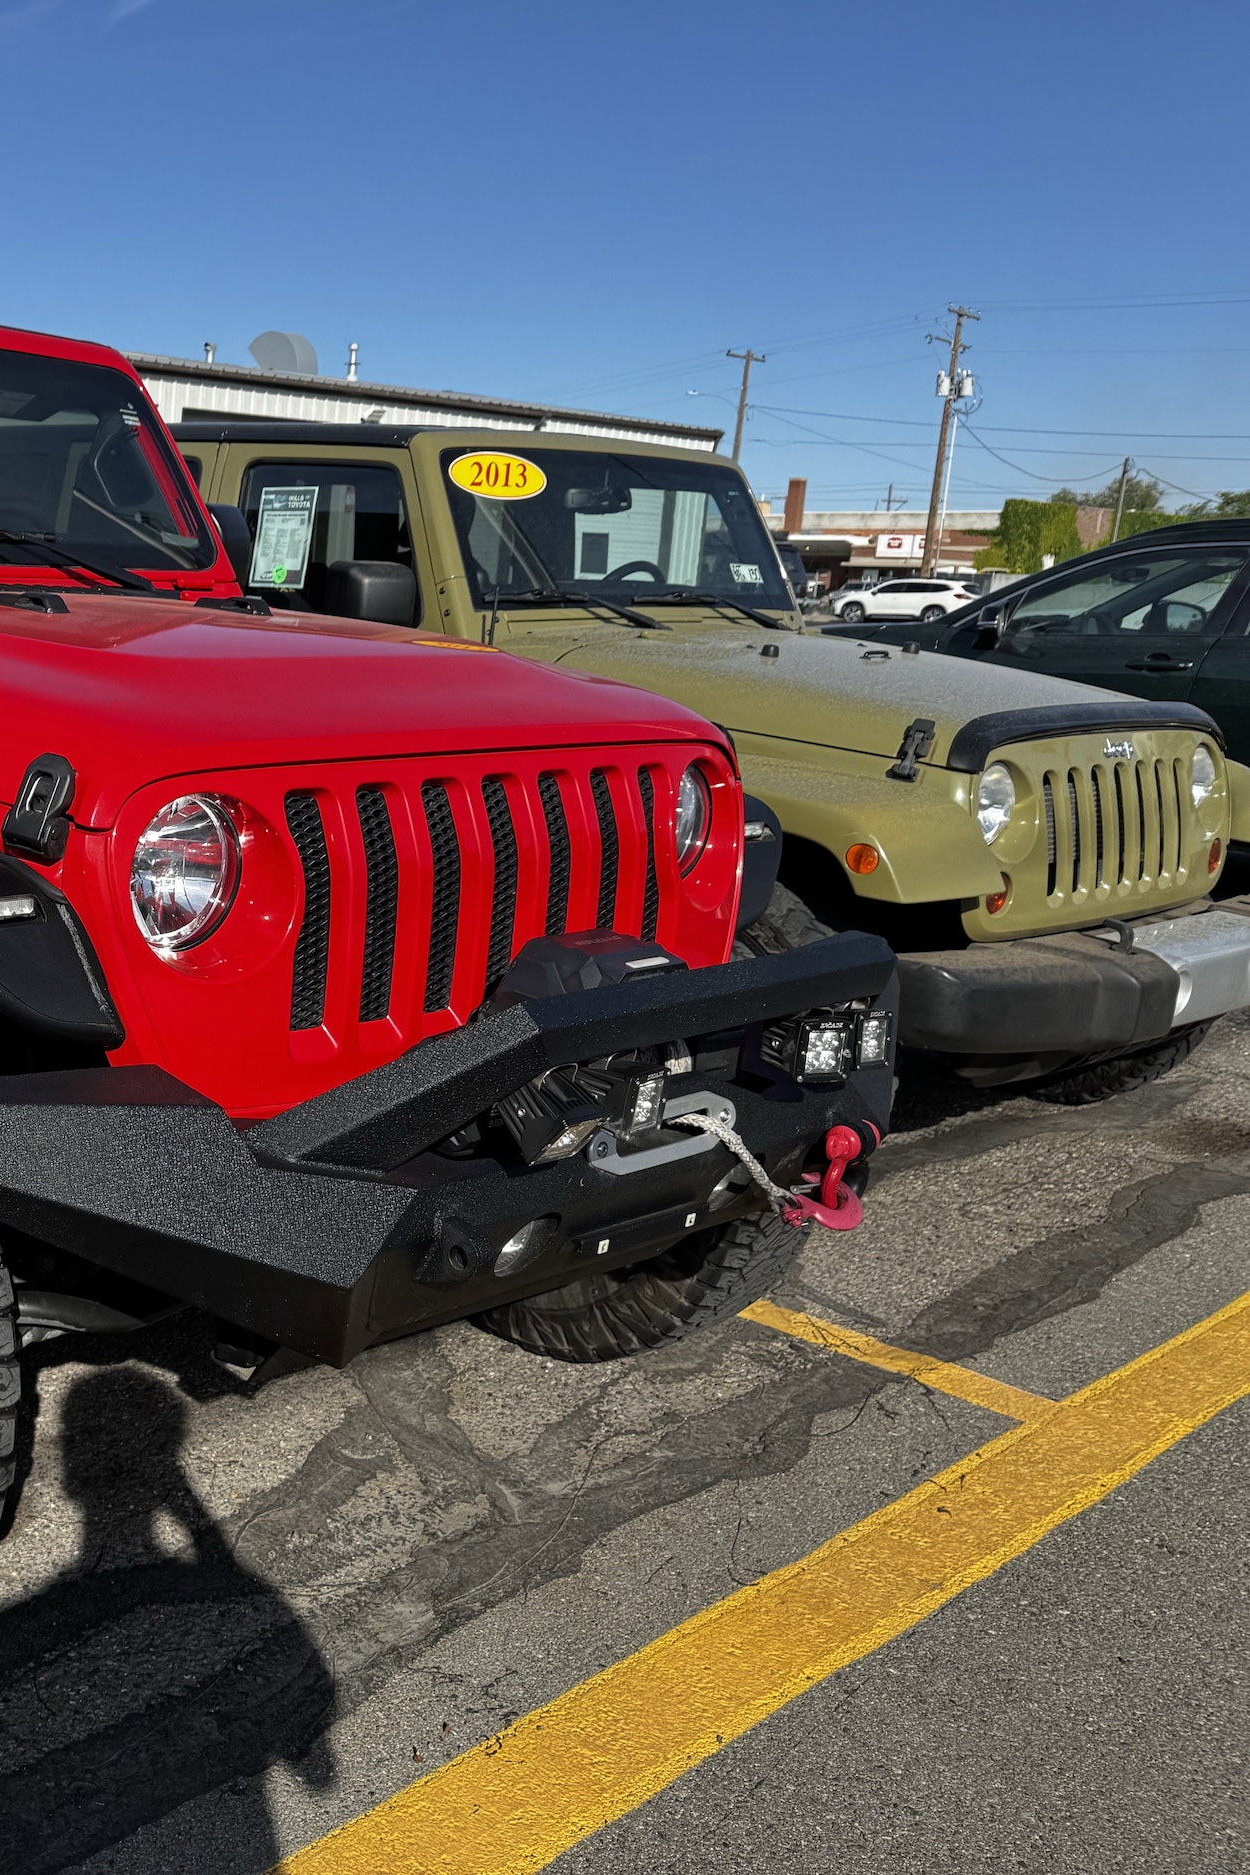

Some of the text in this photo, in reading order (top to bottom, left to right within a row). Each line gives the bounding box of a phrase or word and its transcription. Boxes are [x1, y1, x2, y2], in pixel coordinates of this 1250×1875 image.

[469, 461, 528, 488] 2013
[287, 501, 311, 509] TOYOTA
[1103, 737, 1134, 760] Jeep
